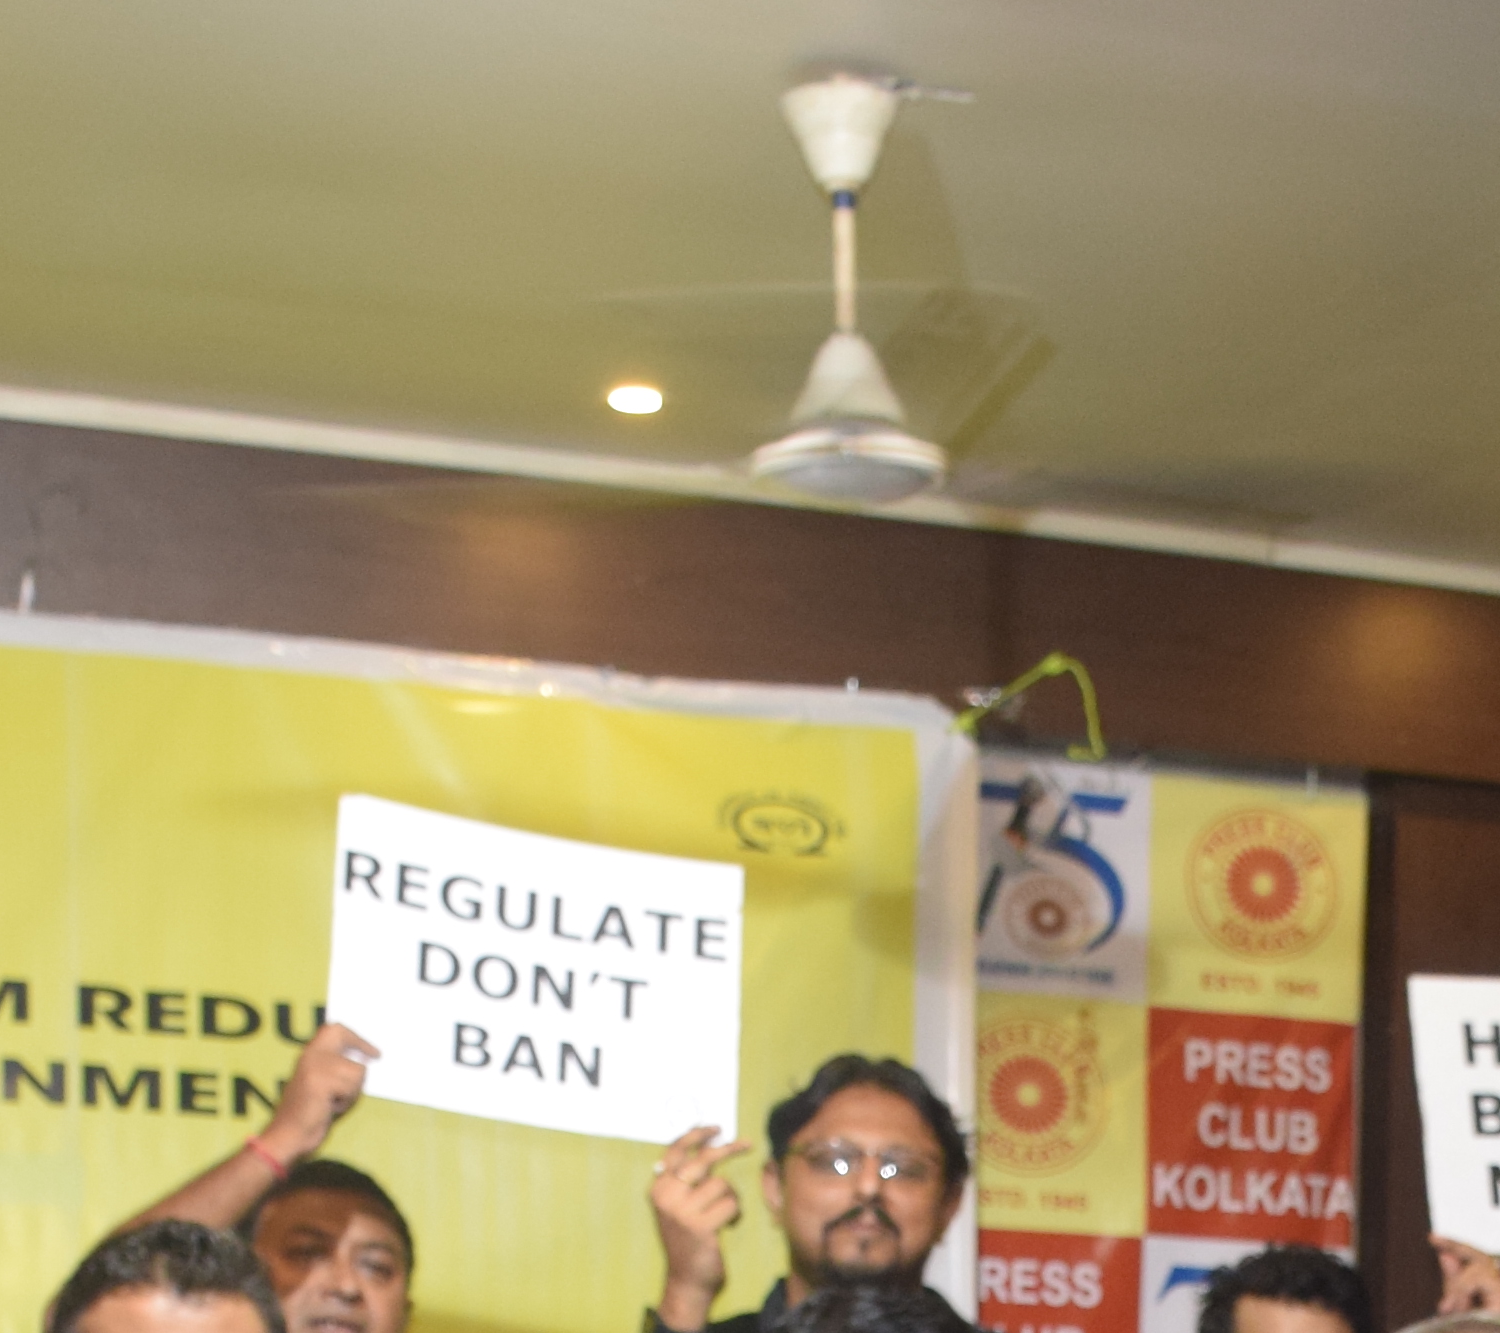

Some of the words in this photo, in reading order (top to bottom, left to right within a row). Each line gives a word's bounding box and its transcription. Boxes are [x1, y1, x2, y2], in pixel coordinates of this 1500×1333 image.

[342, 850, 728, 961] REGULATE
[418, 942, 649, 1021] DON'T
[451, 1022, 604, 1088] BAN
[1184, 1037, 1333, 1094] PRESS
[1198, 1101, 1320, 1155] CLUB
[1151, 1163, 1356, 1221] KOLKATA
[979, 1255, 1103, 1309] RESS
